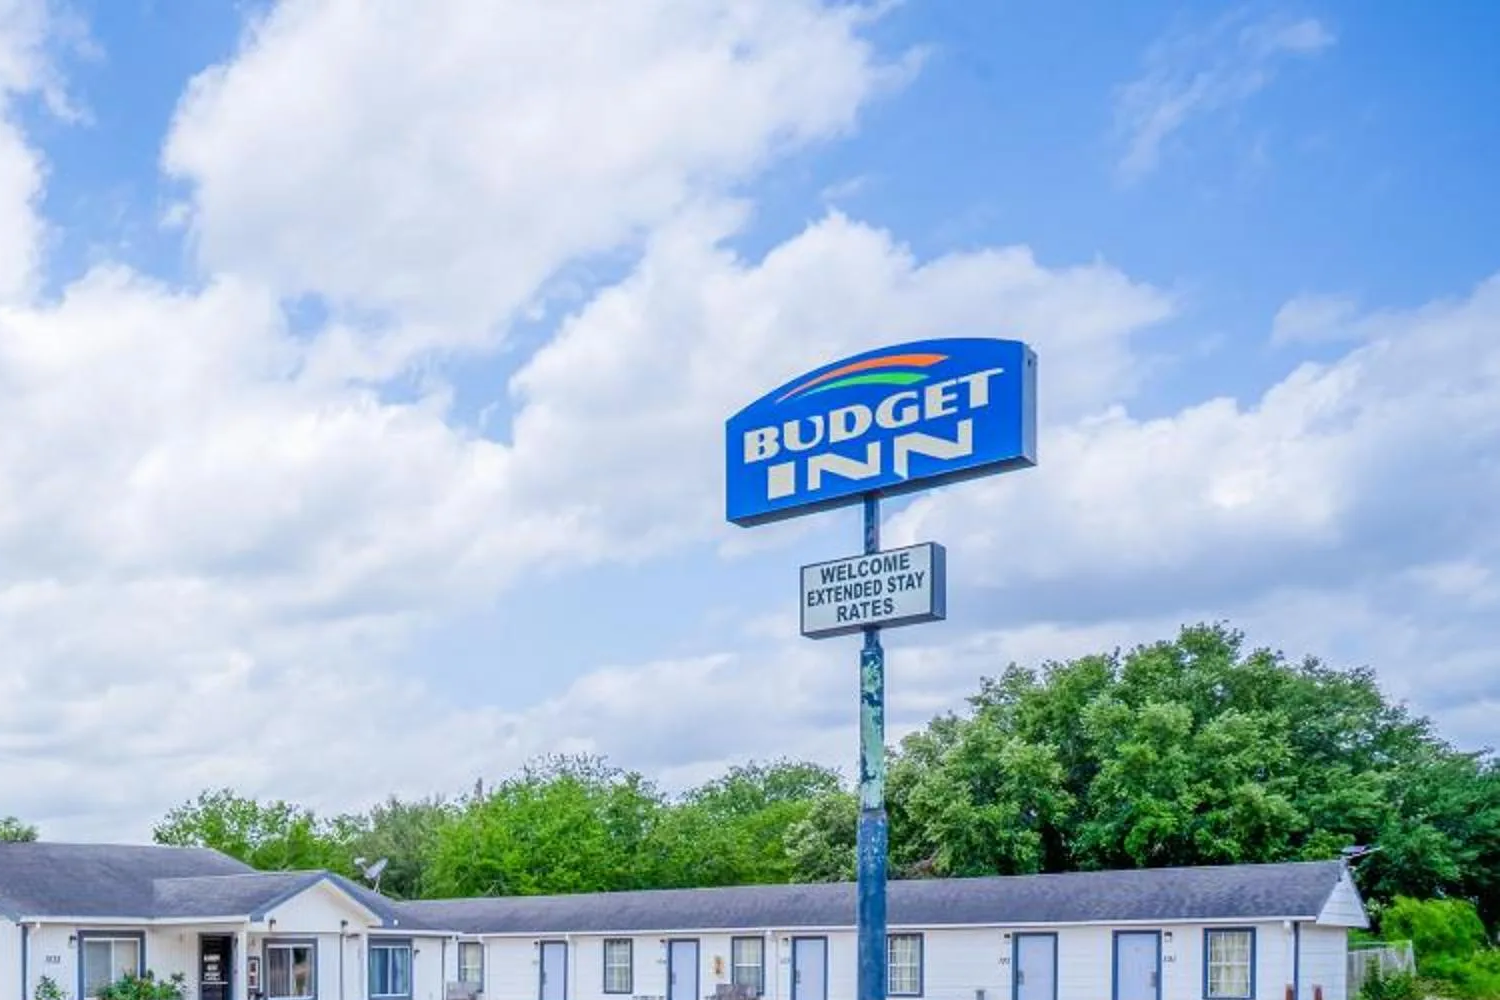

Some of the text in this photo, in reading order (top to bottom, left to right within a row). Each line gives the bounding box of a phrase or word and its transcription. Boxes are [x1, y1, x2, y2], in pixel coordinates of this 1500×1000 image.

[744, 367, 1004, 464] BUDGET
[767, 418, 973, 500] INN
[820, 552, 910, 584] WELCOME
[807, 570, 925, 607] EXTENDED STAY
[836, 597, 894, 622] RATES
